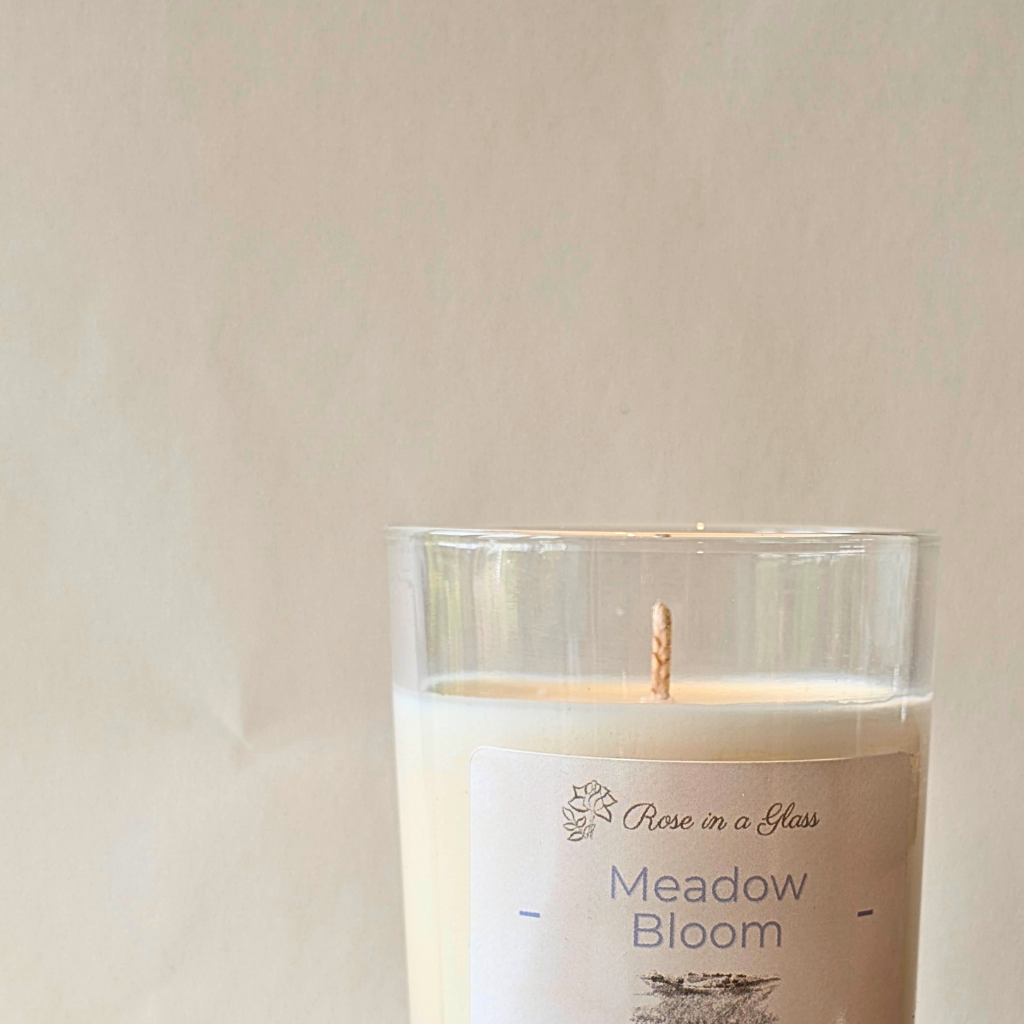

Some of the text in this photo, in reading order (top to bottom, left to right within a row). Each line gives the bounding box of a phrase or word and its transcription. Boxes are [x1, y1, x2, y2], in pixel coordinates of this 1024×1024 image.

[623, 801, 820, 836] Rose in a Glass
[610, 865, 808, 903] Meadow
[633, 912, 782, 949] Bloom
